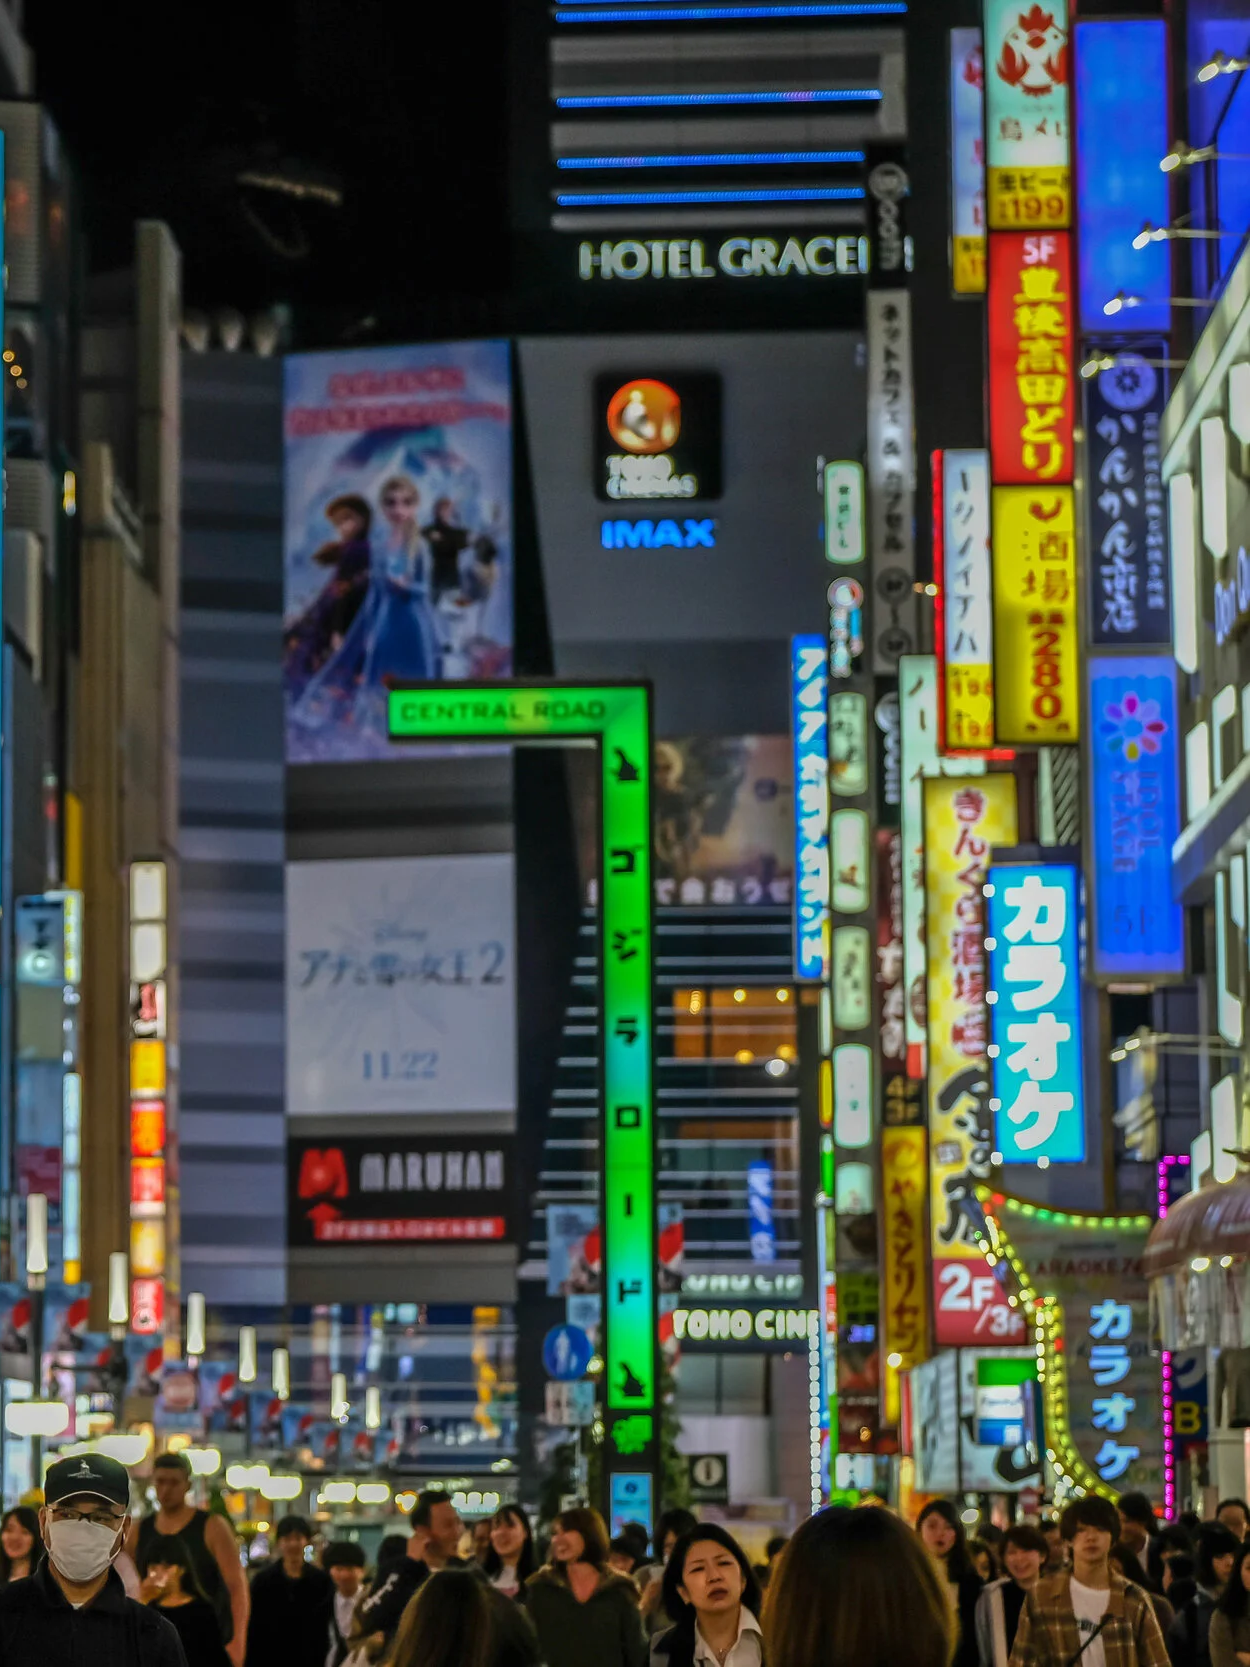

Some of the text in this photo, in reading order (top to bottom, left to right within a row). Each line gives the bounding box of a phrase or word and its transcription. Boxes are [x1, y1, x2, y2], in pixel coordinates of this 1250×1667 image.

[579, 236, 913, 279] HOTEL GRACE
[601, 519, 716, 549] IMAX
[400, 700, 606, 722] CENTRAL ROAD
[1002, 875, 1075, 1152] カラオケ
[362, 1049, 440, 1081] 11.22
[610, 844, 643, 1305] ゴジラロード
[359, 1150, 505, 1192] MARUHAN
[890, 1179, 920, 1357] やきとりセン
[939, 1262, 996, 1313] 2F
[672, 1309, 752, 1341] TOHO
[1088, 1298, 1141, 1482] カラオケ
